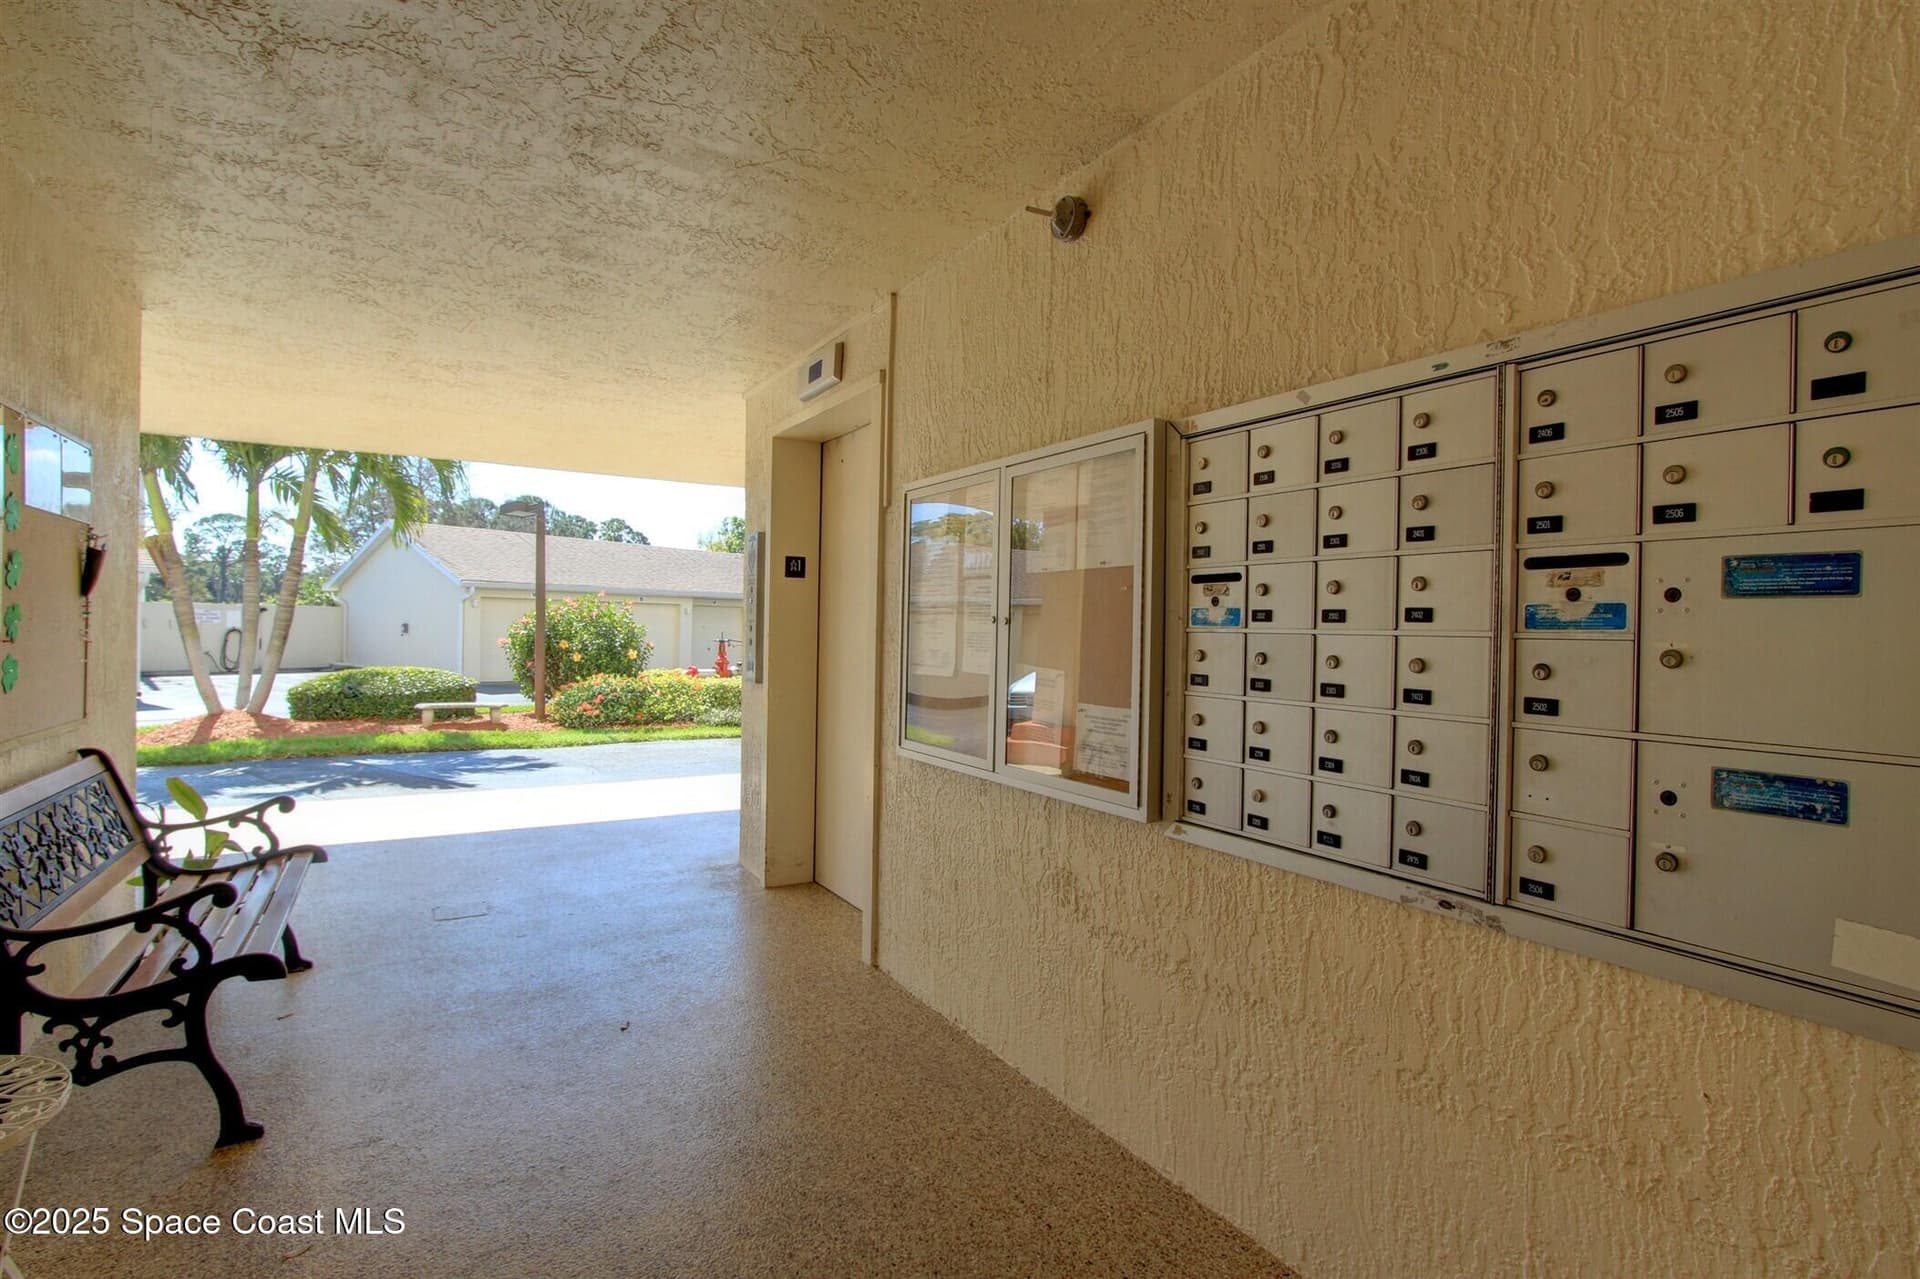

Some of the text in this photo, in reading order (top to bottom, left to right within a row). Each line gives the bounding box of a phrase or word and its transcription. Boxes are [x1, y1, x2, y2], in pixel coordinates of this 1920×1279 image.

[1665, 508, 1684, 519] 2506
[1535, 520, 1551, 529] 2501
[1532, 702, 1548, 712] 2502
[1528, 884, 1543, 896] 2504
